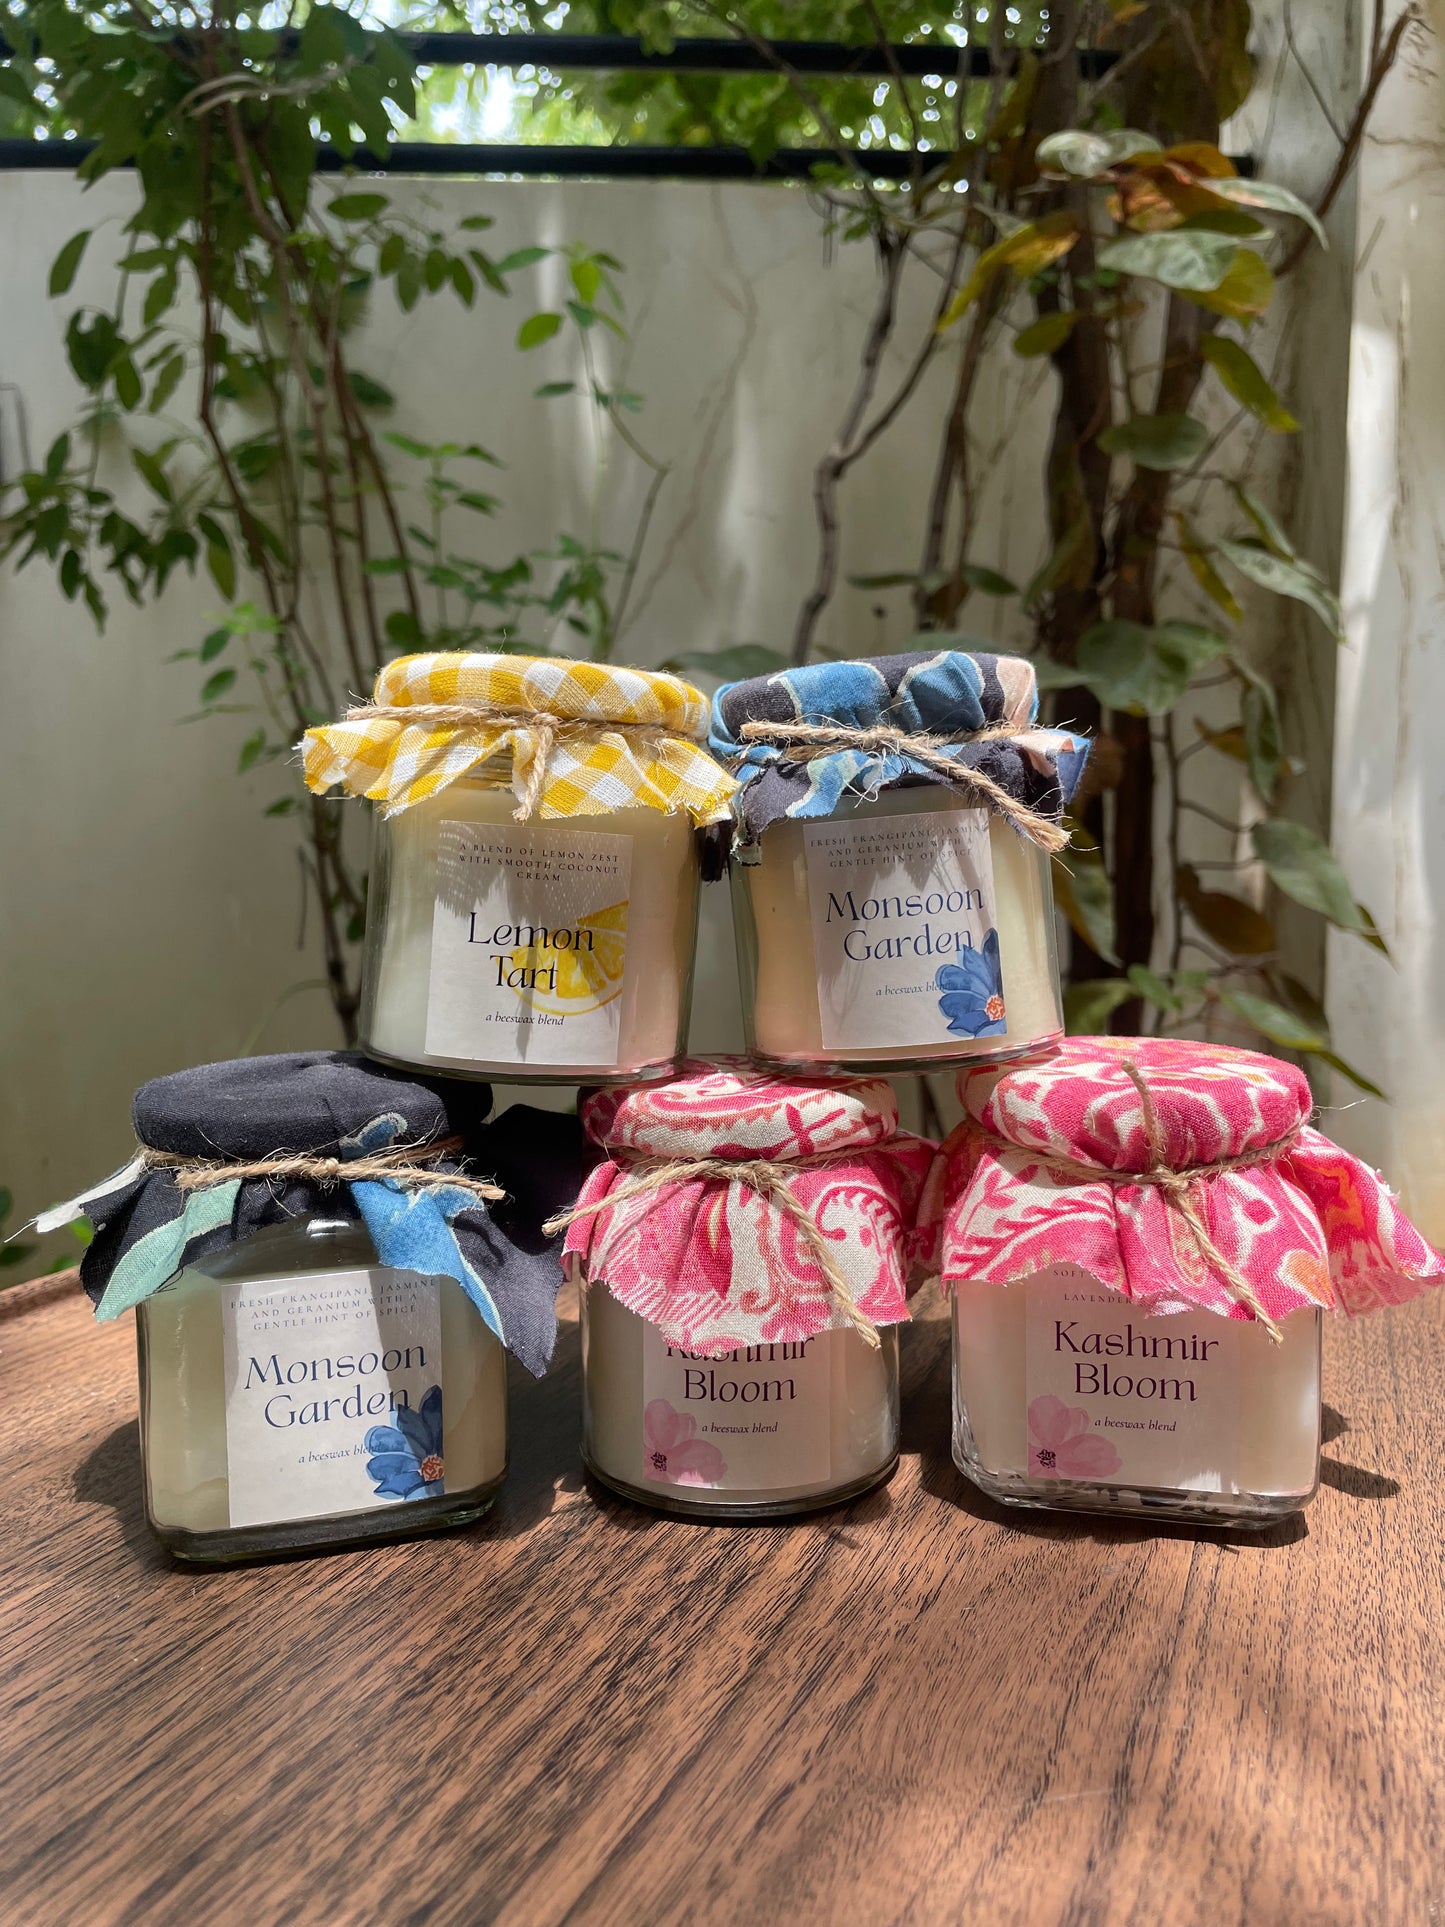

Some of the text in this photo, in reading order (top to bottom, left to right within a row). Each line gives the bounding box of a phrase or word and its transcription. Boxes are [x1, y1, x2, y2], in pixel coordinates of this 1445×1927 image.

[460, 843, 620, 863] A BLEND OF LEMON ZEST
[810, 837, 847, 848] FRESH
[827, 846, 857, 858] AND
[858, 840, 925, 855] GERANIUM
[459, 855, 620, 875] WITH SMOOTH COCONUT
[829, 856, 878, 868] GENTLE
[882, 852, 913, 864] HINT
[920, 850, 936, 861] OF
[516, 871, 561, 882] CREAM
[825, 888, 985, 923] Monsoon
[467, 911, 596, 951] Lemon
[843, 923, 976, 961] Garden
[489, 954, 559, 990] Tart
[875, 987, 882, 996] a
[884, 984, 923, 996] beeswax
[485, 1011, 565, 1026] a beeswax blend
[1053, 1269, 1086, 1279] SOFT
[231, 1296, 275, 1310] FRESH
[380, 1277, 436, 1295] JASMINE
[251, 1293, 418, 1320] AND GERANIUM WITH A
[253, 1303, 418, 1332] GENTLE HINT OF SPICE
[1054, 1320, 1220, 1361] Kashmir
[244, 1346, 428, 1390] Monsoon
[683, 1368, 798, 1403] Bloom
[1074, 1362, 1199, 1402] Bloom
[264, 1384, 412, 1428] Garden
[701, 1421, 779, 1434] a beeswax blend
[1094, 1416, 1177, 1432] a beeswax blend
[298, 1455, 305, 1464] a
[308, 1449, 350, 1463] beeswax
